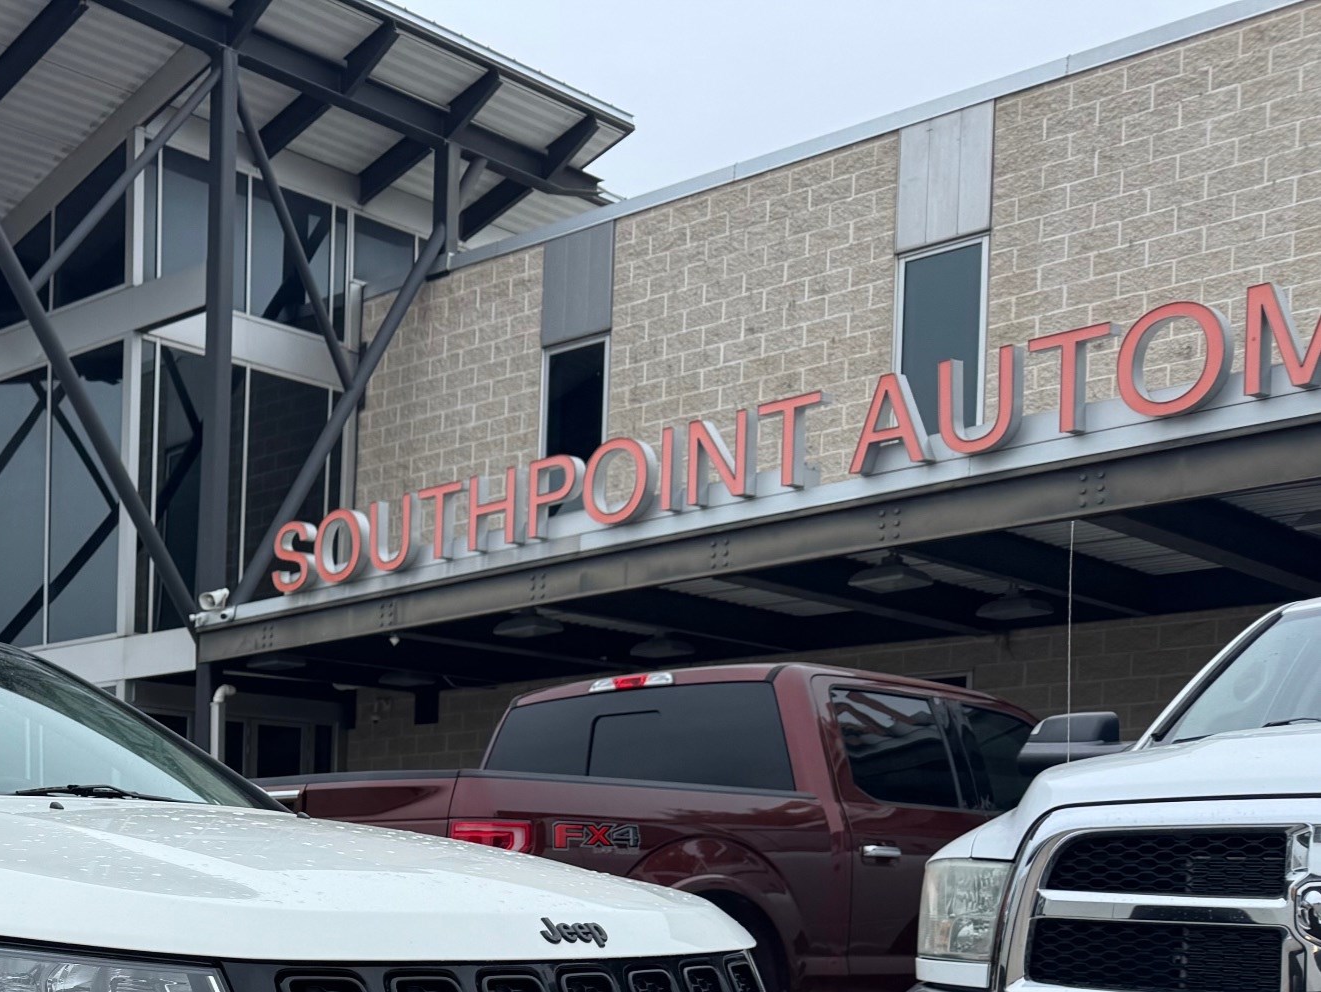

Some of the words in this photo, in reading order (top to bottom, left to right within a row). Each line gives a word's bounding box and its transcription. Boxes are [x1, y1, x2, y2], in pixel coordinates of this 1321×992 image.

[271, 390, 828, 592] SOUTHPOINT
[552, 821, 640, 850] FX4
[540, 917, 609, 948] Jeep
